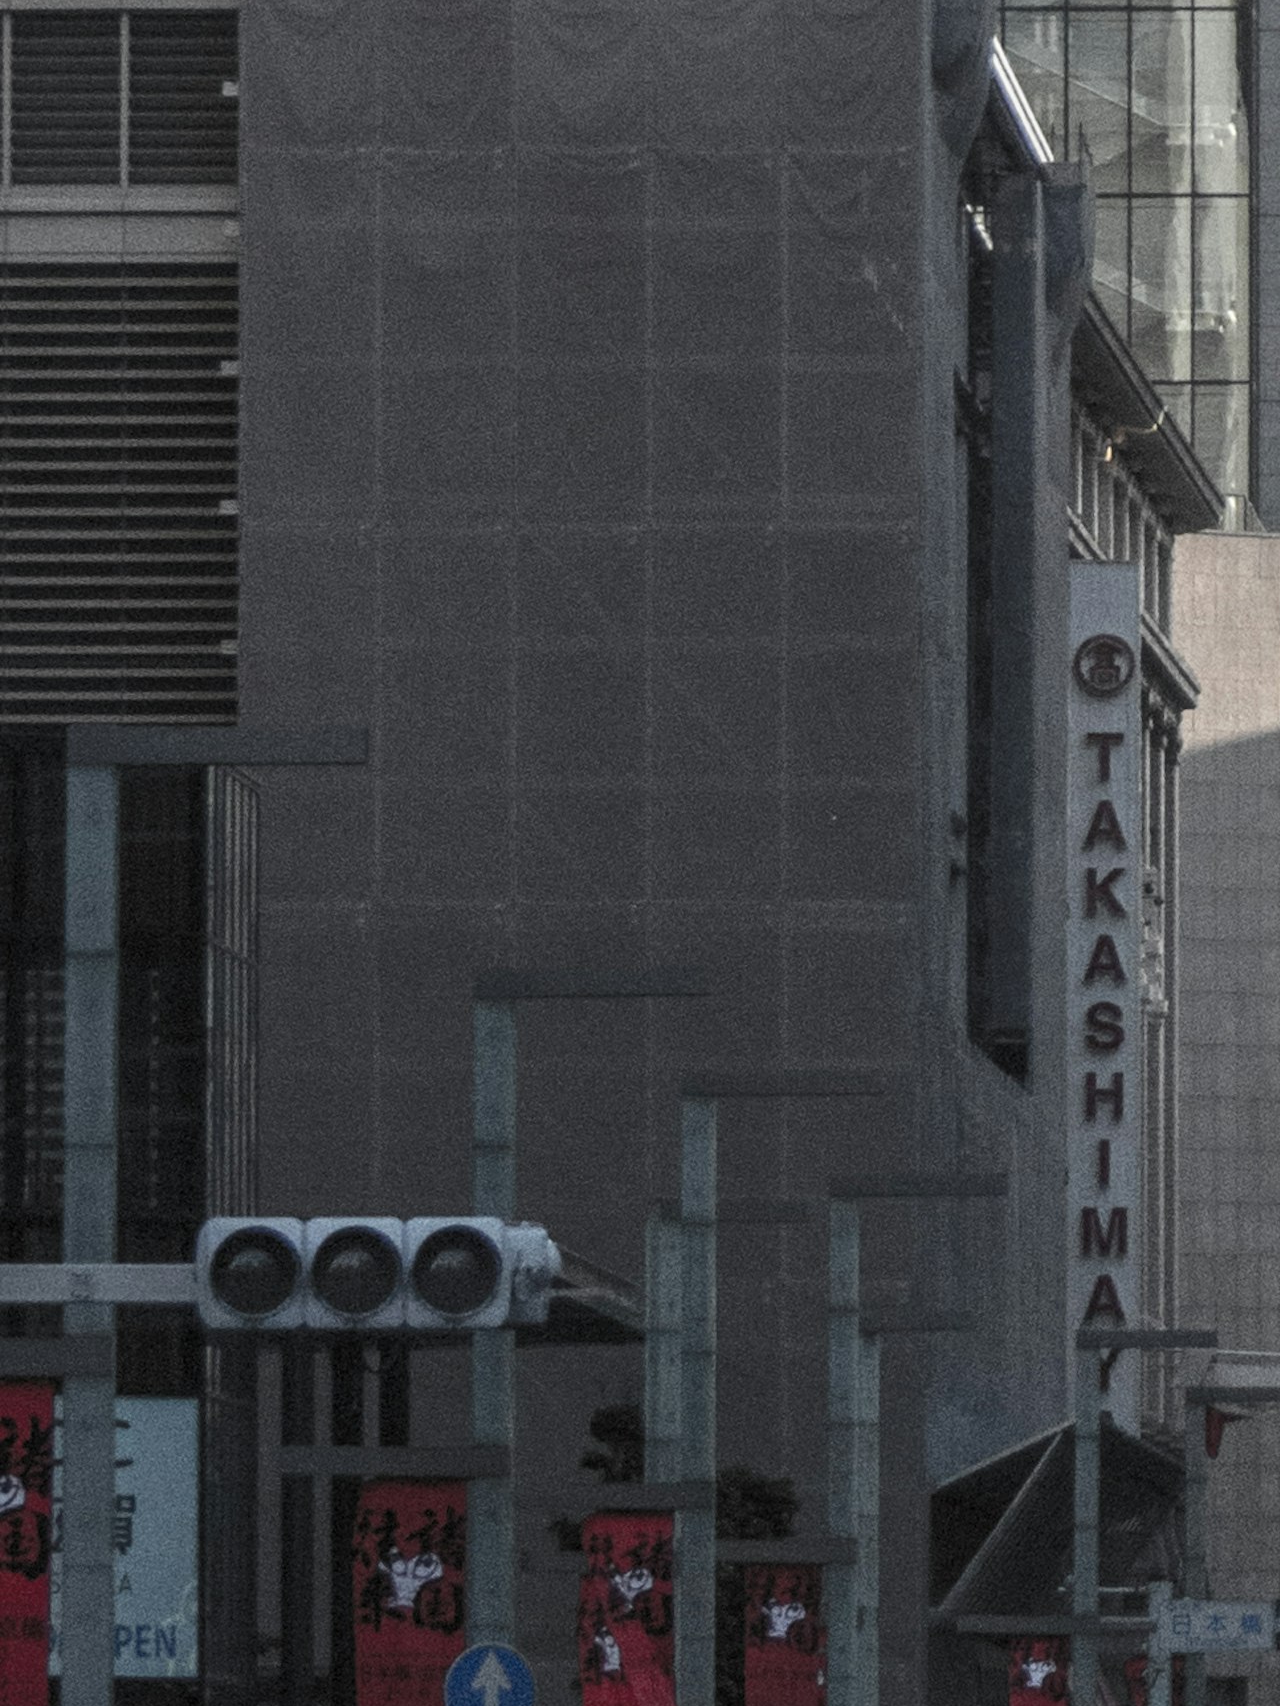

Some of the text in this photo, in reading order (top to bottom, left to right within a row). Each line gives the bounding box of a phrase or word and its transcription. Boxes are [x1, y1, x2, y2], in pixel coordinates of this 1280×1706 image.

[1172, 1613, 1263, 1636] 日本橋
[114, 1625, 177, 1659] PEN
